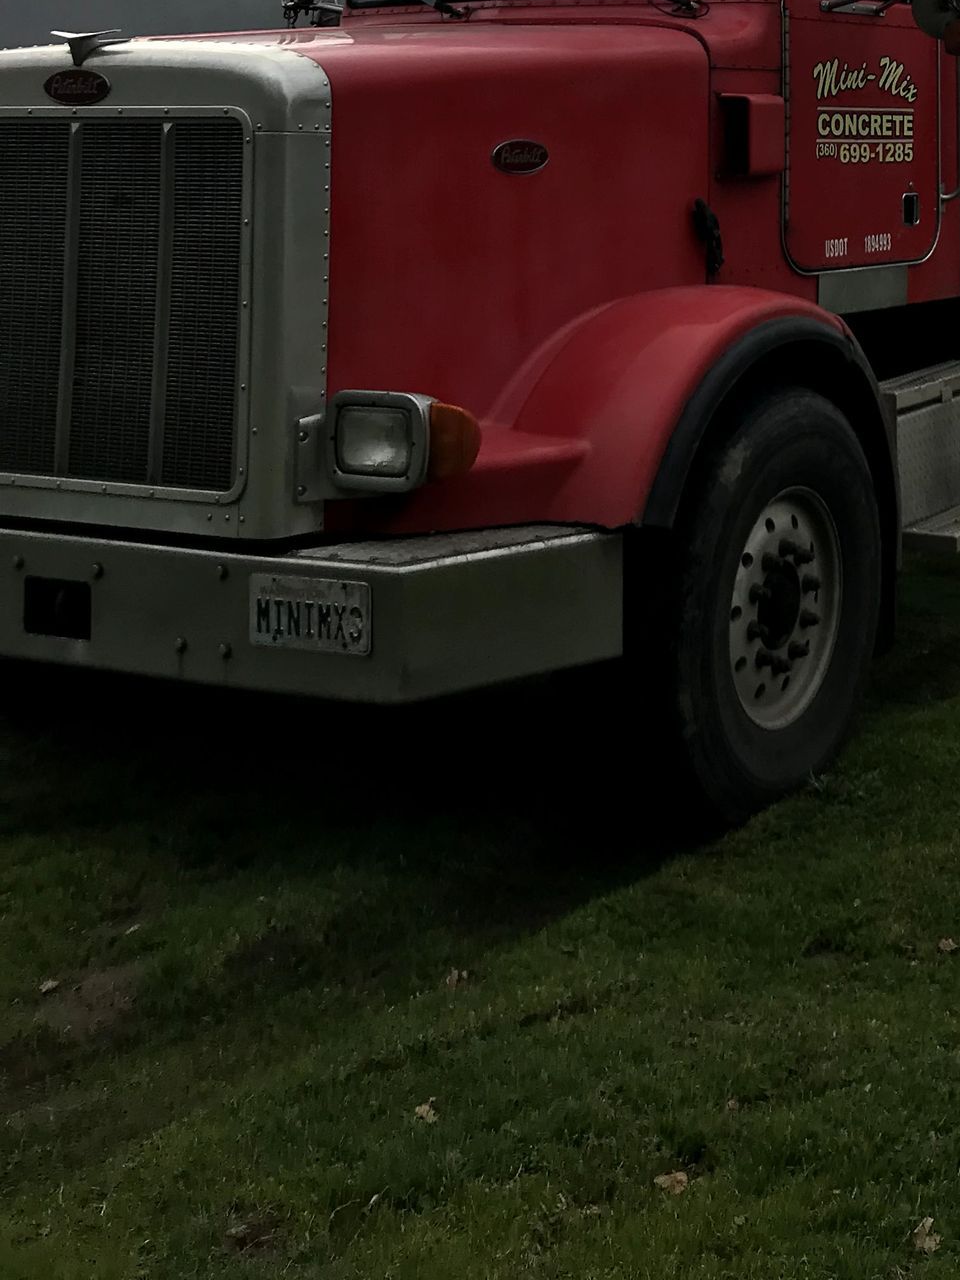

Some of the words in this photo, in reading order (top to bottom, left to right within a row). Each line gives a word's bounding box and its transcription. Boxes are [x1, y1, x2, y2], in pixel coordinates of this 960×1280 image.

[813, 56, 918, 102] Mini-Mix
[817, 113, 914, 137] CONCRETE
[815, 143, 838, 159] (360)
[839, 143, 914, 163] 699-1285
[825, 238, 849, 258] USDOT
